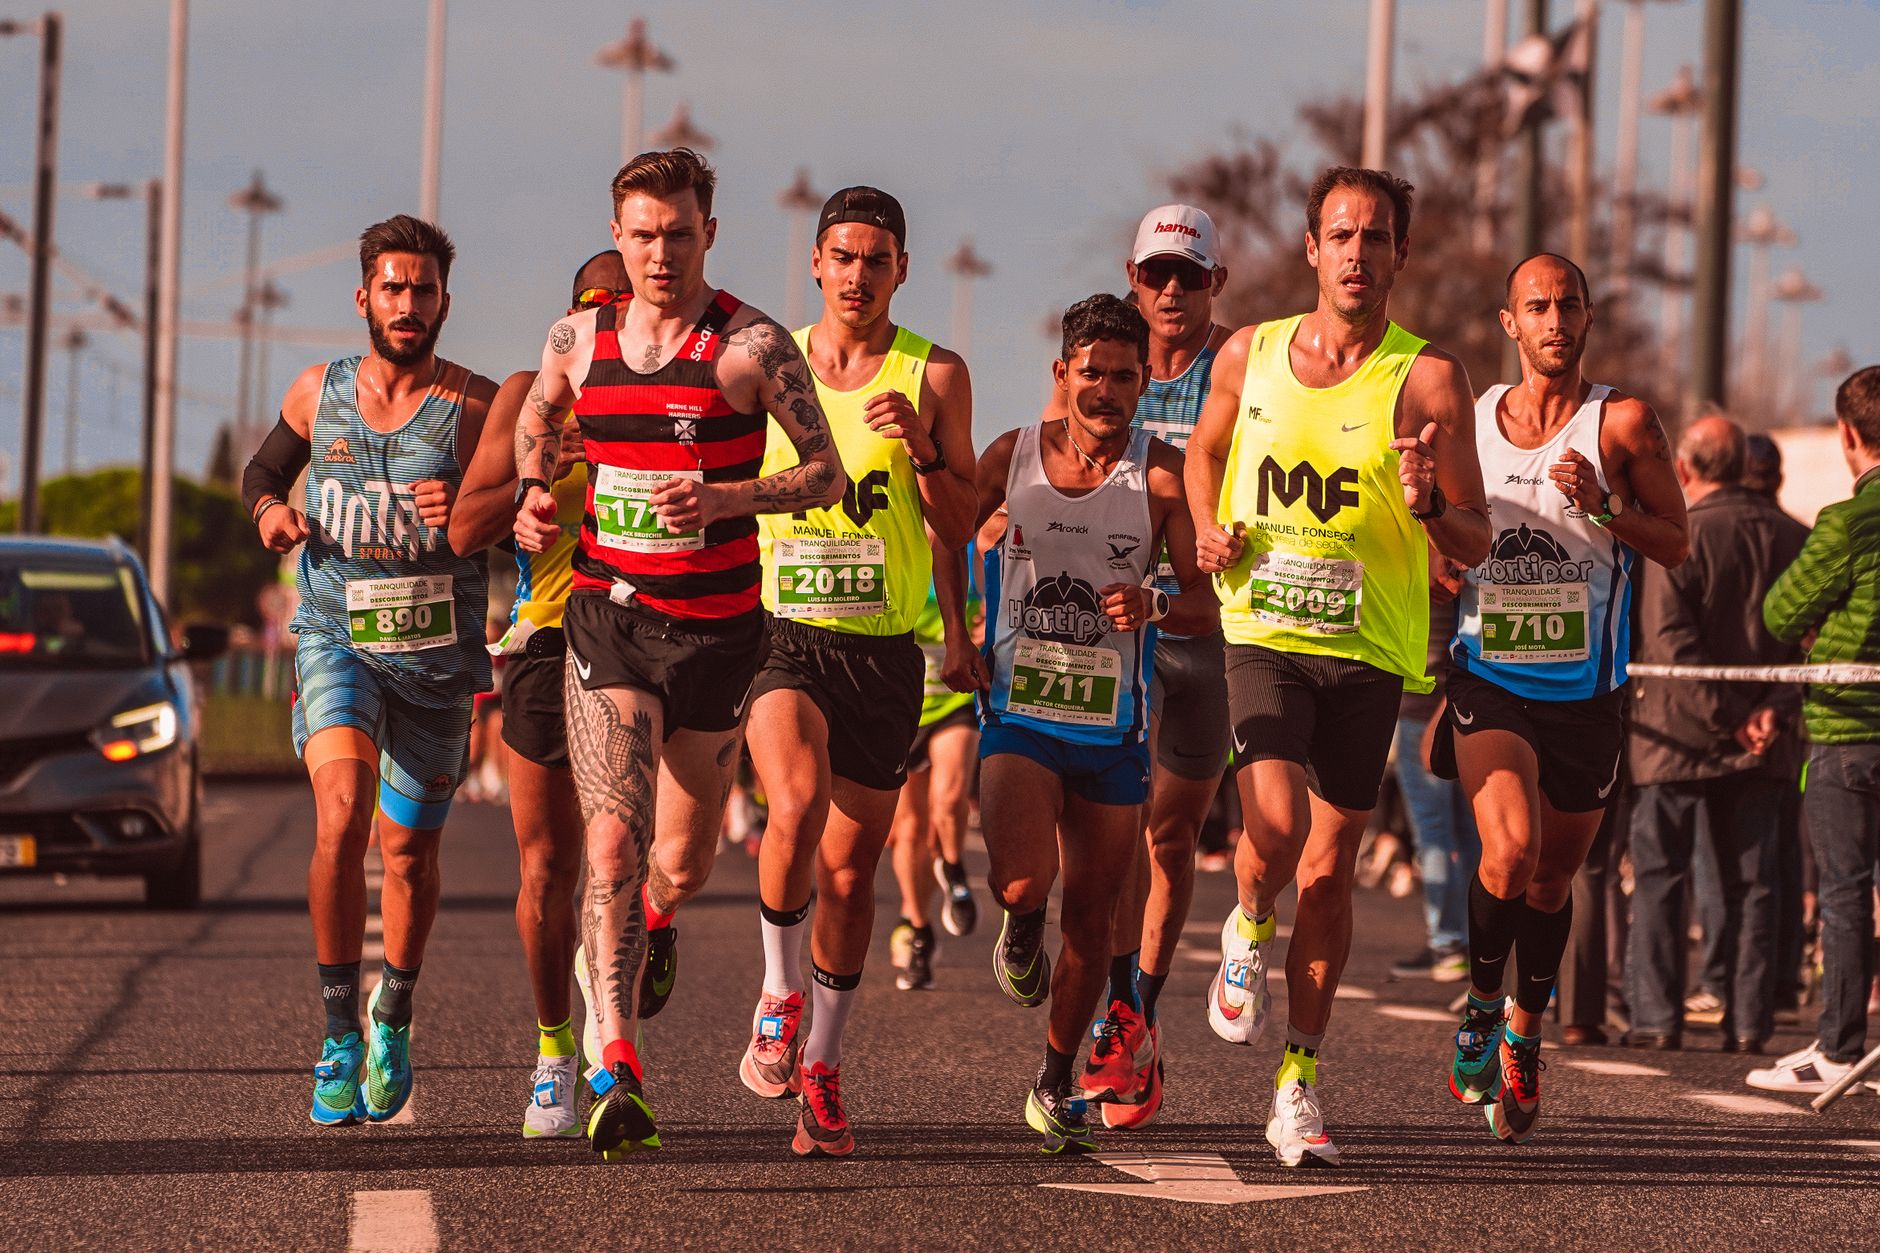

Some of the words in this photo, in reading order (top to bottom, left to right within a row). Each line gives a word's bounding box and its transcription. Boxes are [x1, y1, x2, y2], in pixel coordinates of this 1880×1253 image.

[690, 323, 714, 361] soar
[666, 403, 688, 411] HERNE
[668, 411, 702, 419] HARRIERS
[613, 470, 674, 482] TRANQUILIDADE
[1504, 474, 1545, 486] Aronick
[1257, 455, 1359, 524] MF
[794, 526, 837, 539] MANUEL
[1046, 521, 1089, 534] Aronick
[1255, 521, 1299, 535] MANUEL
[1302, 527, 1356, 542] FONSECA
[799, 540, 861, 548] TRANQUILIDADE
[1299, 537, 1313, 548] de
[360, 548, 404, 560] SPORTS
[1277, 558, 1337, 572] TRANQUILIDADE
[795, 566, 875, 594] 2018
[1274, 571, 1336, 584] DESCOBRIMENTOS
[369, 580, 428, 592] TRANQUILIDADE
[1501, 587, 1561, 596] TRANQUILIDADE
[370, 593, 428, 604] DESCOBRIMENTOS
[1266, 583, 1347, 616] 2009
[376, 605, 432, 633] 890
[1009, 599, 1116, 641] Hortipo
[1506, 614, 1565, 641] 710
[1039, 643, 1098, 659] TRANQUILIDADE
[1515, 643, 1527, 651] JOSÉ
[1036, 657, 1095, 671] DESCOBRIMENTOS
[1039, 671, 1094, 703] 711
[1033, 699, 1054, 708] VICTOR
[1054, 703, 1085, 711] CERQUEIRA
